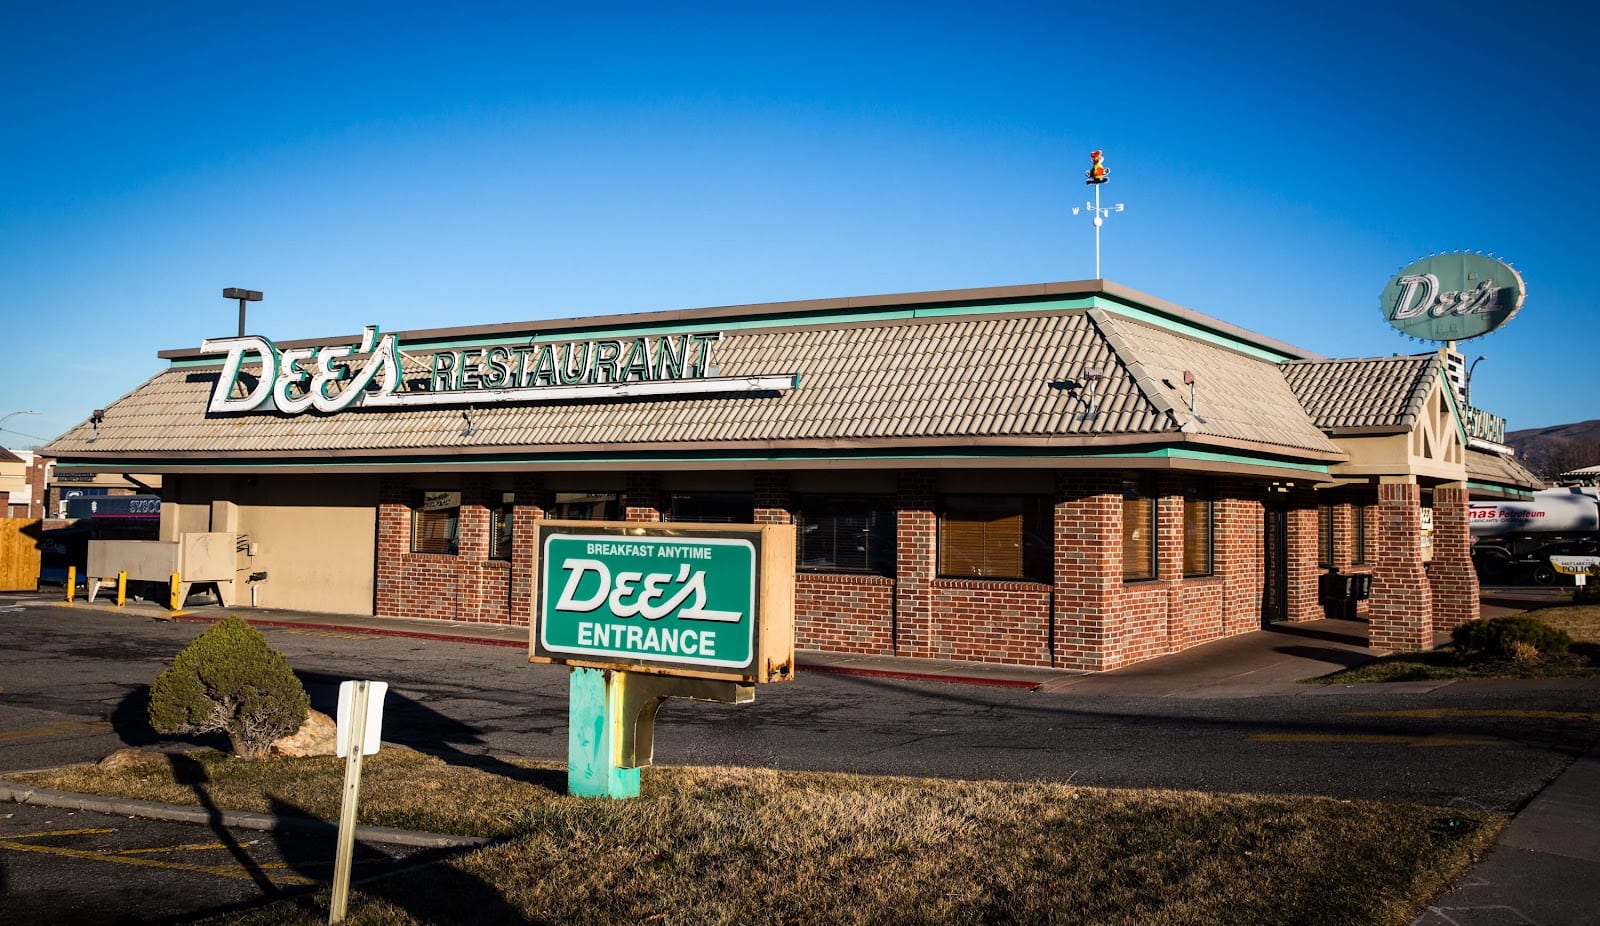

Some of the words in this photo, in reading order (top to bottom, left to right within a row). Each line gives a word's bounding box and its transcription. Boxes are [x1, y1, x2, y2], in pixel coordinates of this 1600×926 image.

[430, 332, 724, 391] RESTAURANT
[1498, 510, 1546, 518] Petroleum
[587, 543, 655, 557] BREAKFAST
[657, 546, 712, 560] ANYTIME
[577, 621, 716, 656] ENTRANCE
